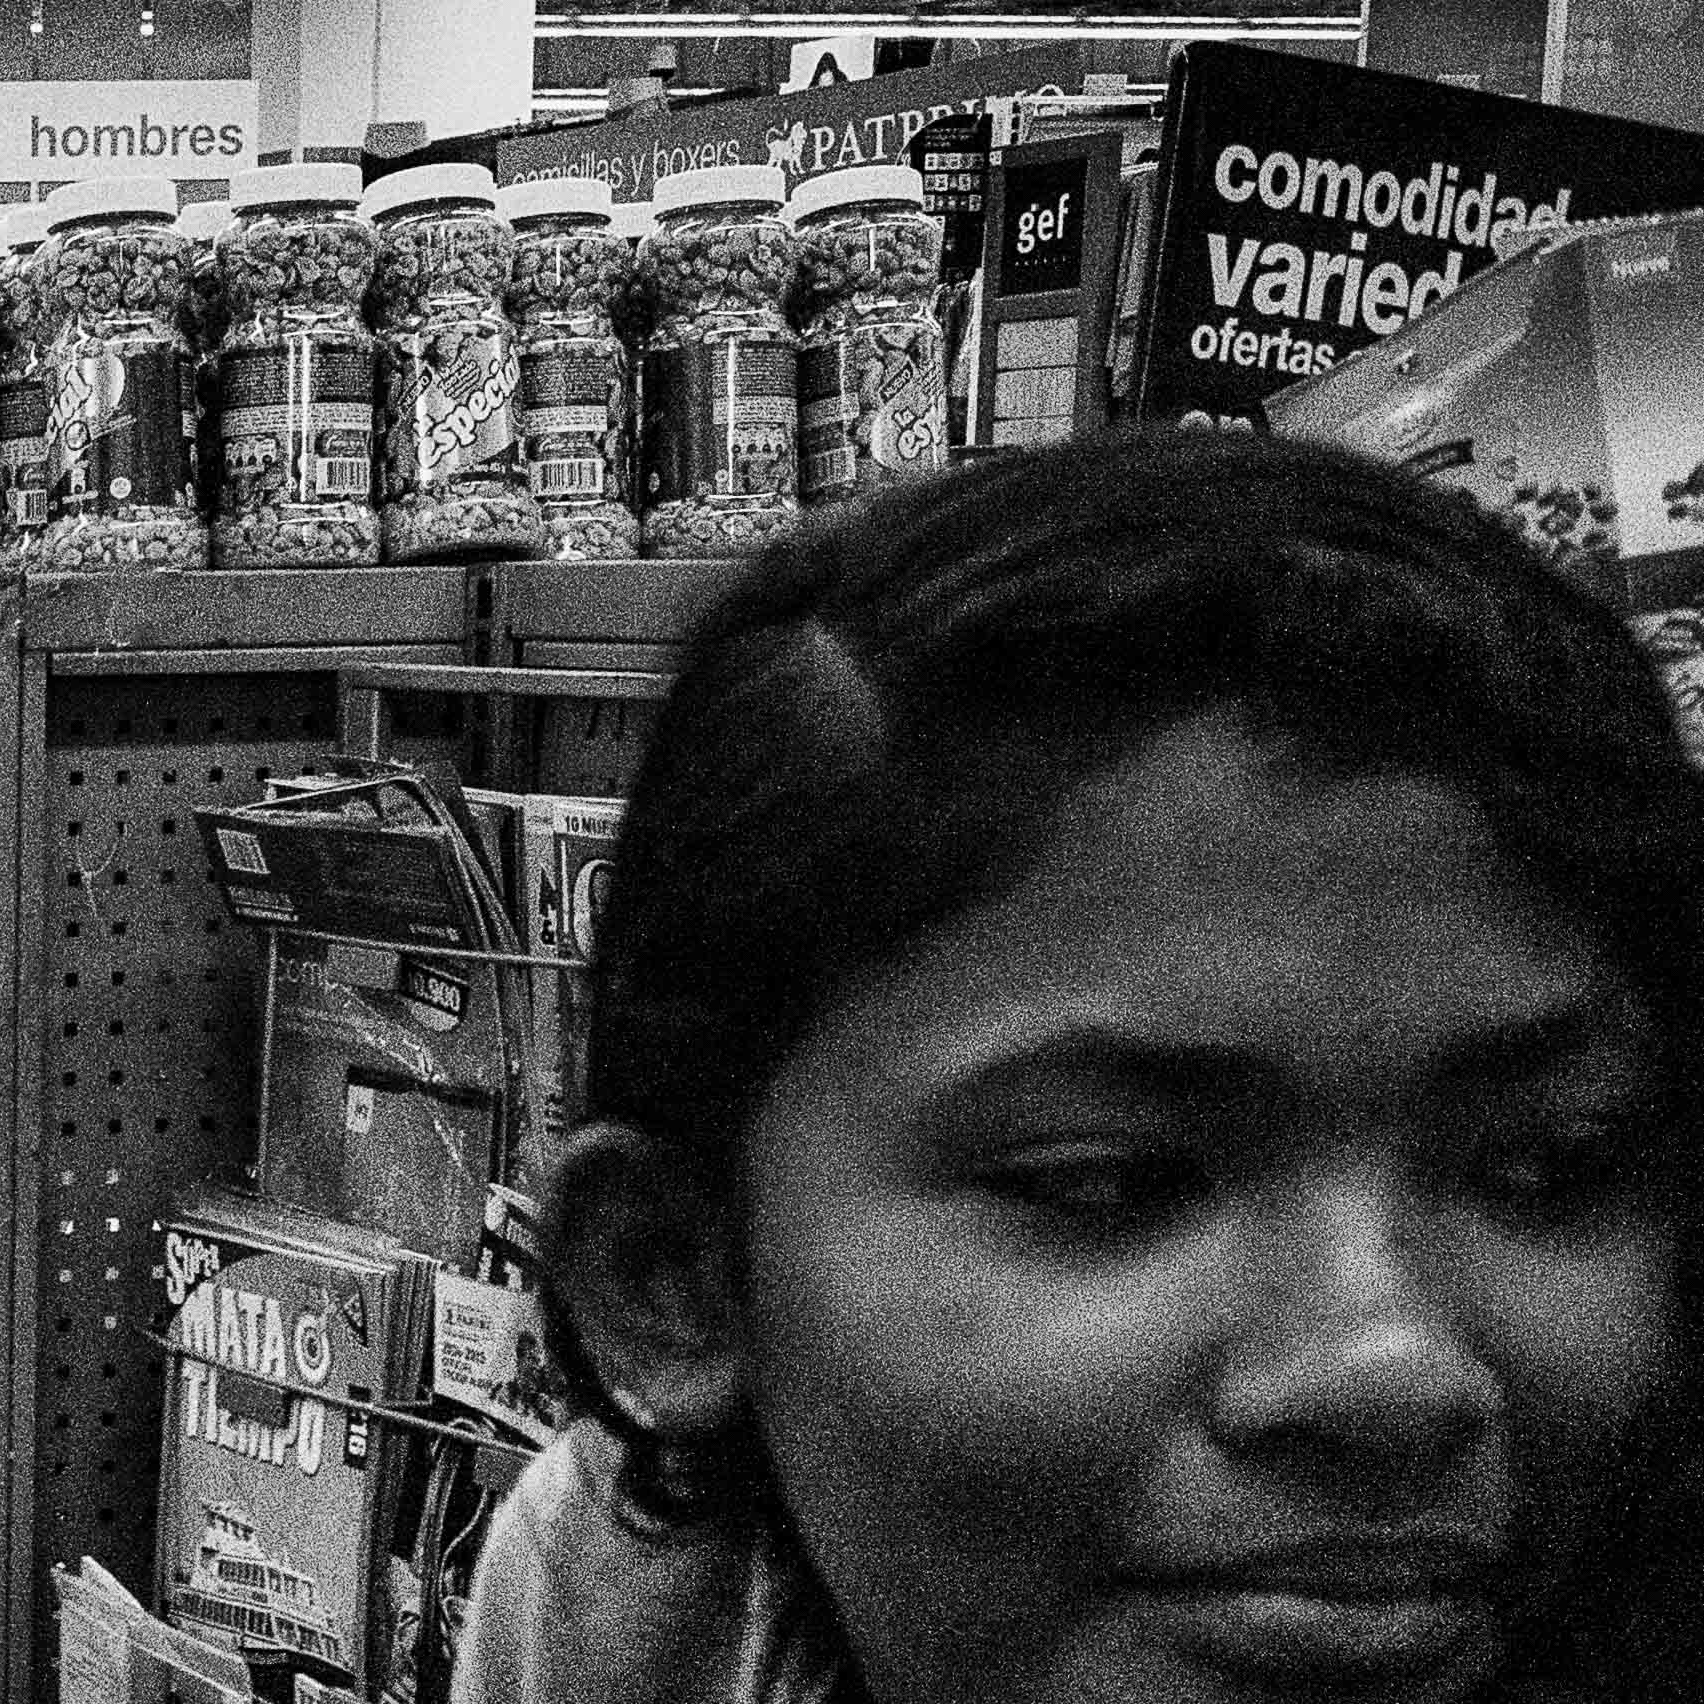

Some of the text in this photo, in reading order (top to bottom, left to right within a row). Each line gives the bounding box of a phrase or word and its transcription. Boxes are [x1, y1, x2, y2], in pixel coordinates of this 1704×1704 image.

[29, 114, 244, 159] hombres
[631, 152, 646, 196] y
[653, 139, 741, 182] boxers
[1016, 193, 1071, 254] gef
[1190, 317, 1335, 376] ofertas
[417, 344, 521, 469] especial
[182, 1281, 287, 1380] MATA
